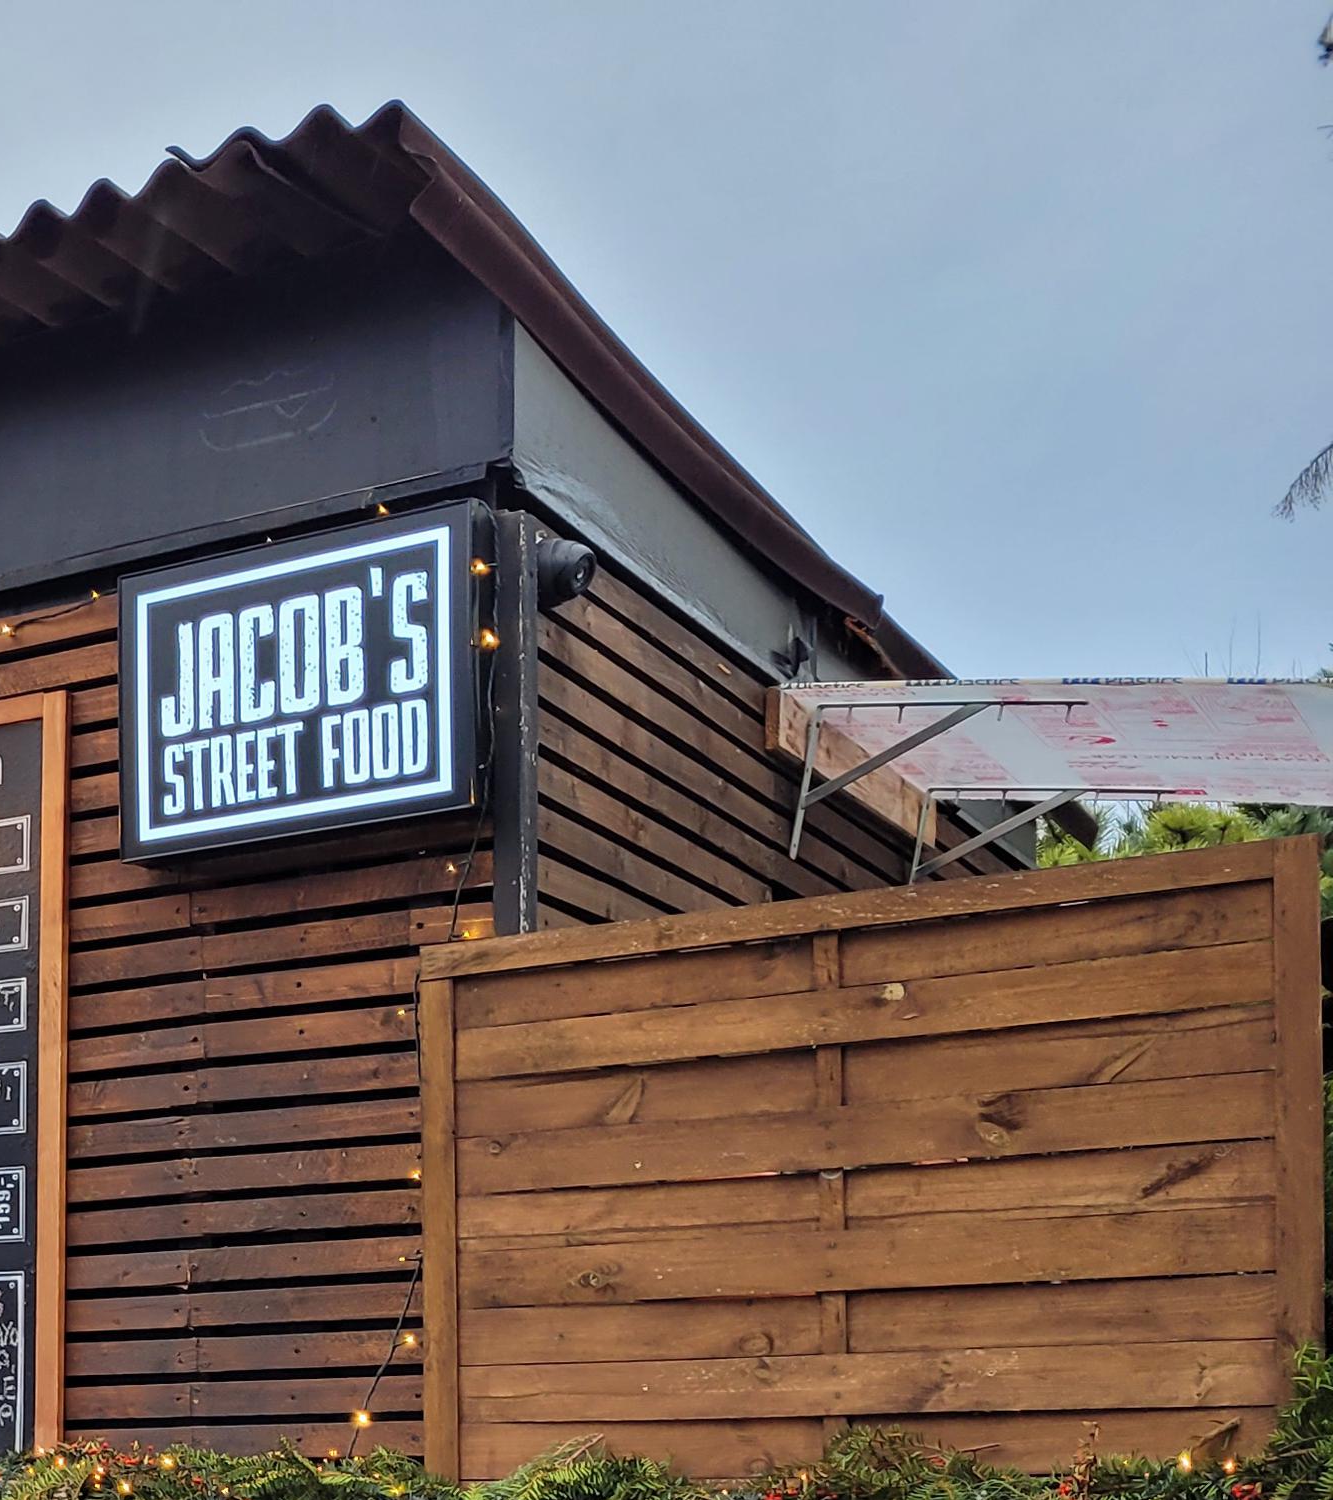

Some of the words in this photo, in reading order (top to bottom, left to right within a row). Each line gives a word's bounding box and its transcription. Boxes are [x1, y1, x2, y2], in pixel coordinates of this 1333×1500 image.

[161, 567, 428, 737] JACOB'S
[163, 722, 303, 816] STREET
[321, 699, 428, 788] FOOD
